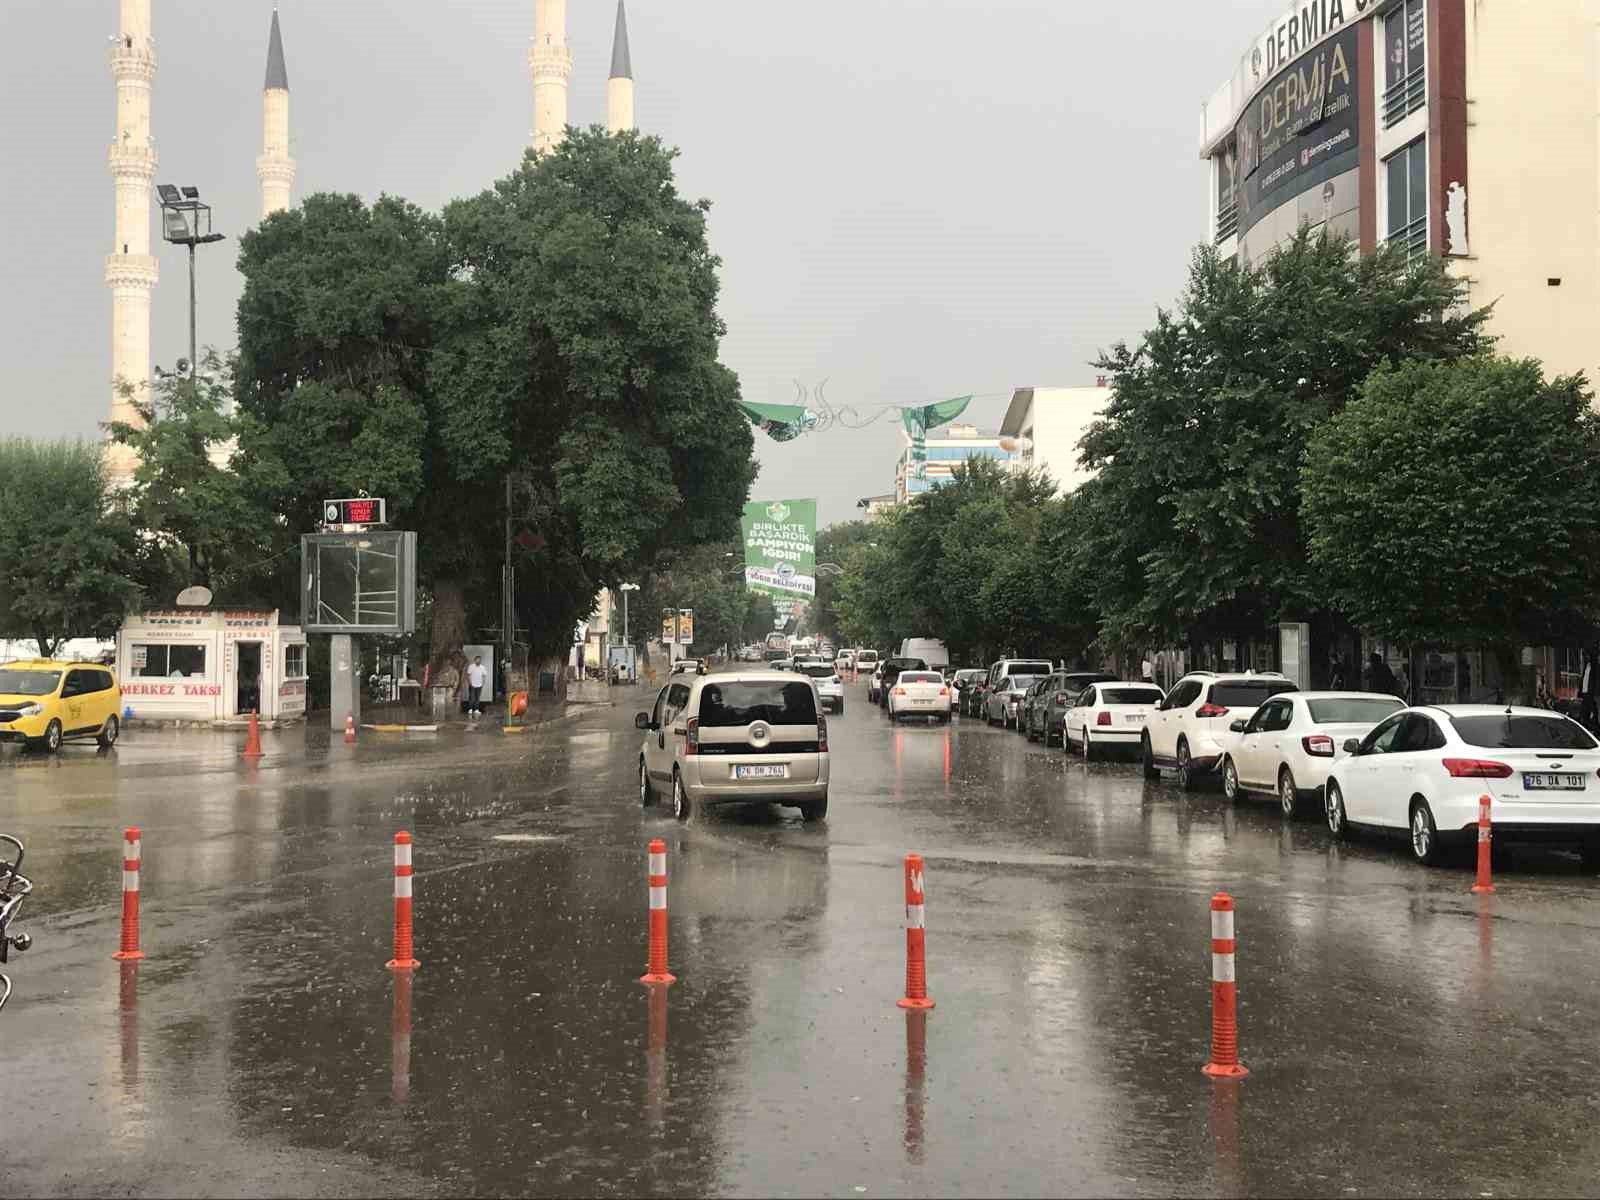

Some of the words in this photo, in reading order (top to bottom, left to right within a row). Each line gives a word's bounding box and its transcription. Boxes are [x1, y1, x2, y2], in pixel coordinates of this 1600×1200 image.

[121, 684, 175, 696] MERKEZ
[1531, 775, 1542, 785] 76
[1548, 775, 1560, 785] DA
[1567, 775, 1583, 785] 101
